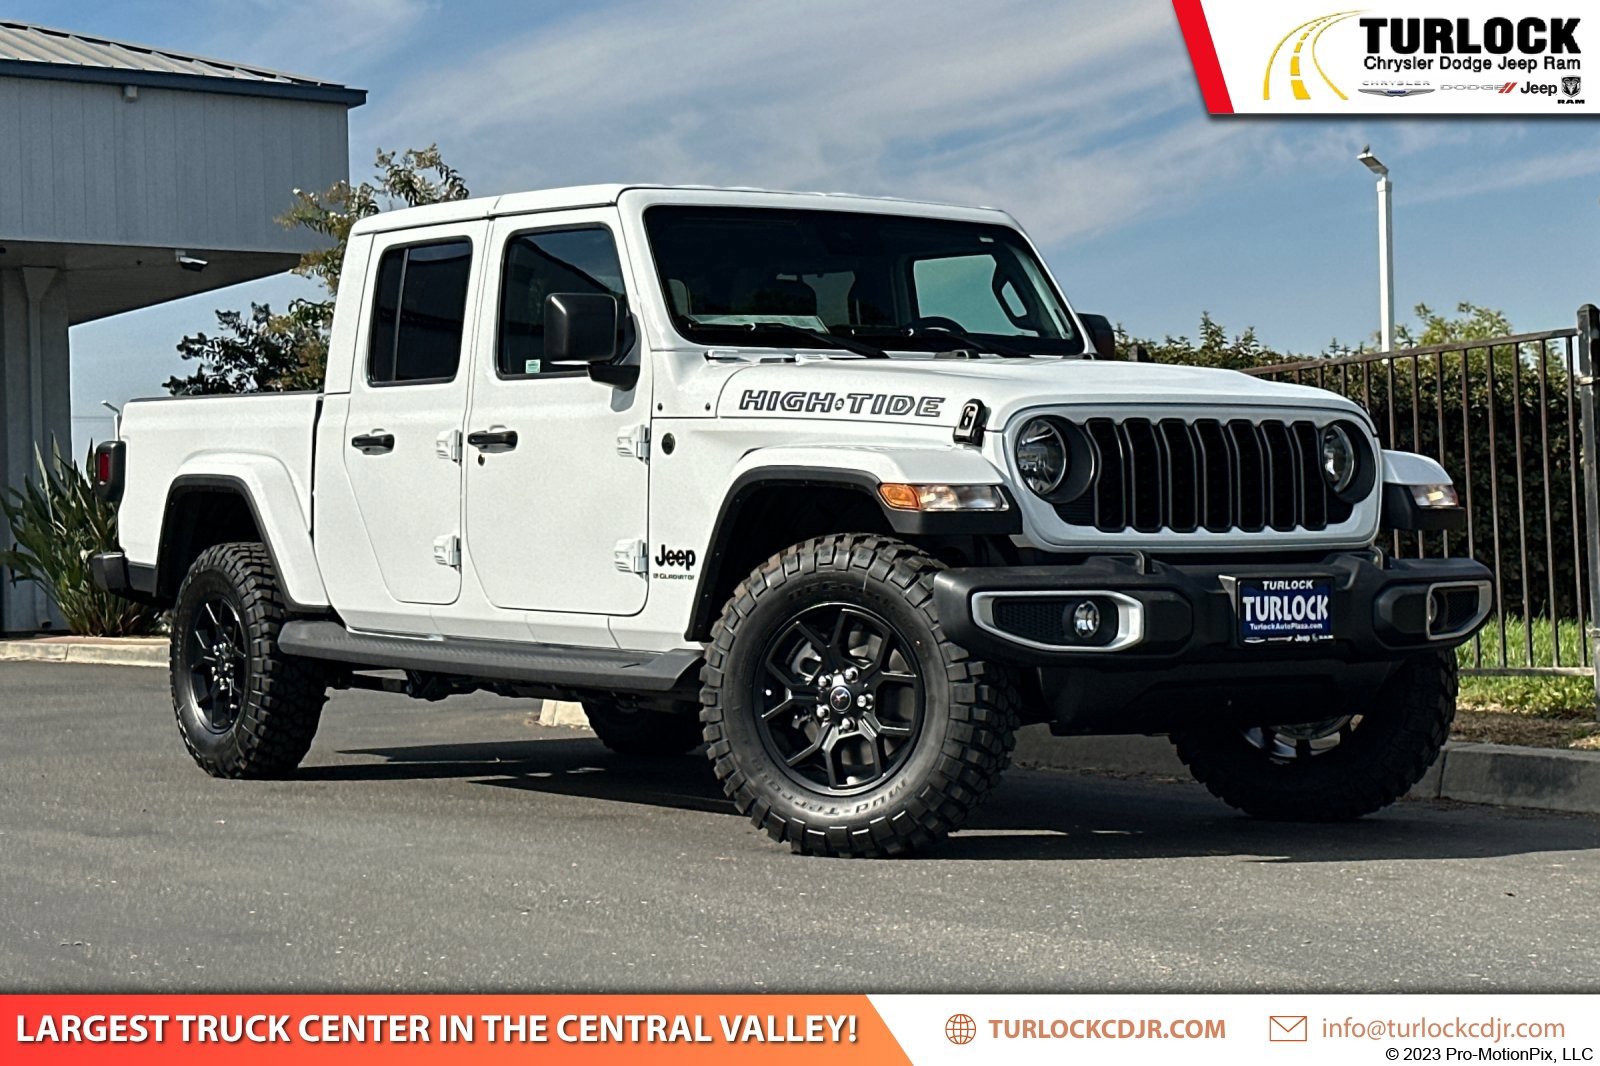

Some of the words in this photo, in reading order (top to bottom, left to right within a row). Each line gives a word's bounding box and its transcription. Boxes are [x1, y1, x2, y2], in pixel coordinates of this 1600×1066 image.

[655, 544, 696, 571] Jeep
[1262, 580, 1314, 591] TURLOCK
[1242, 594, 1329, 622] TURLOCK
[1249, 622, 1323, 631] TurlockAutoPlaza.com
